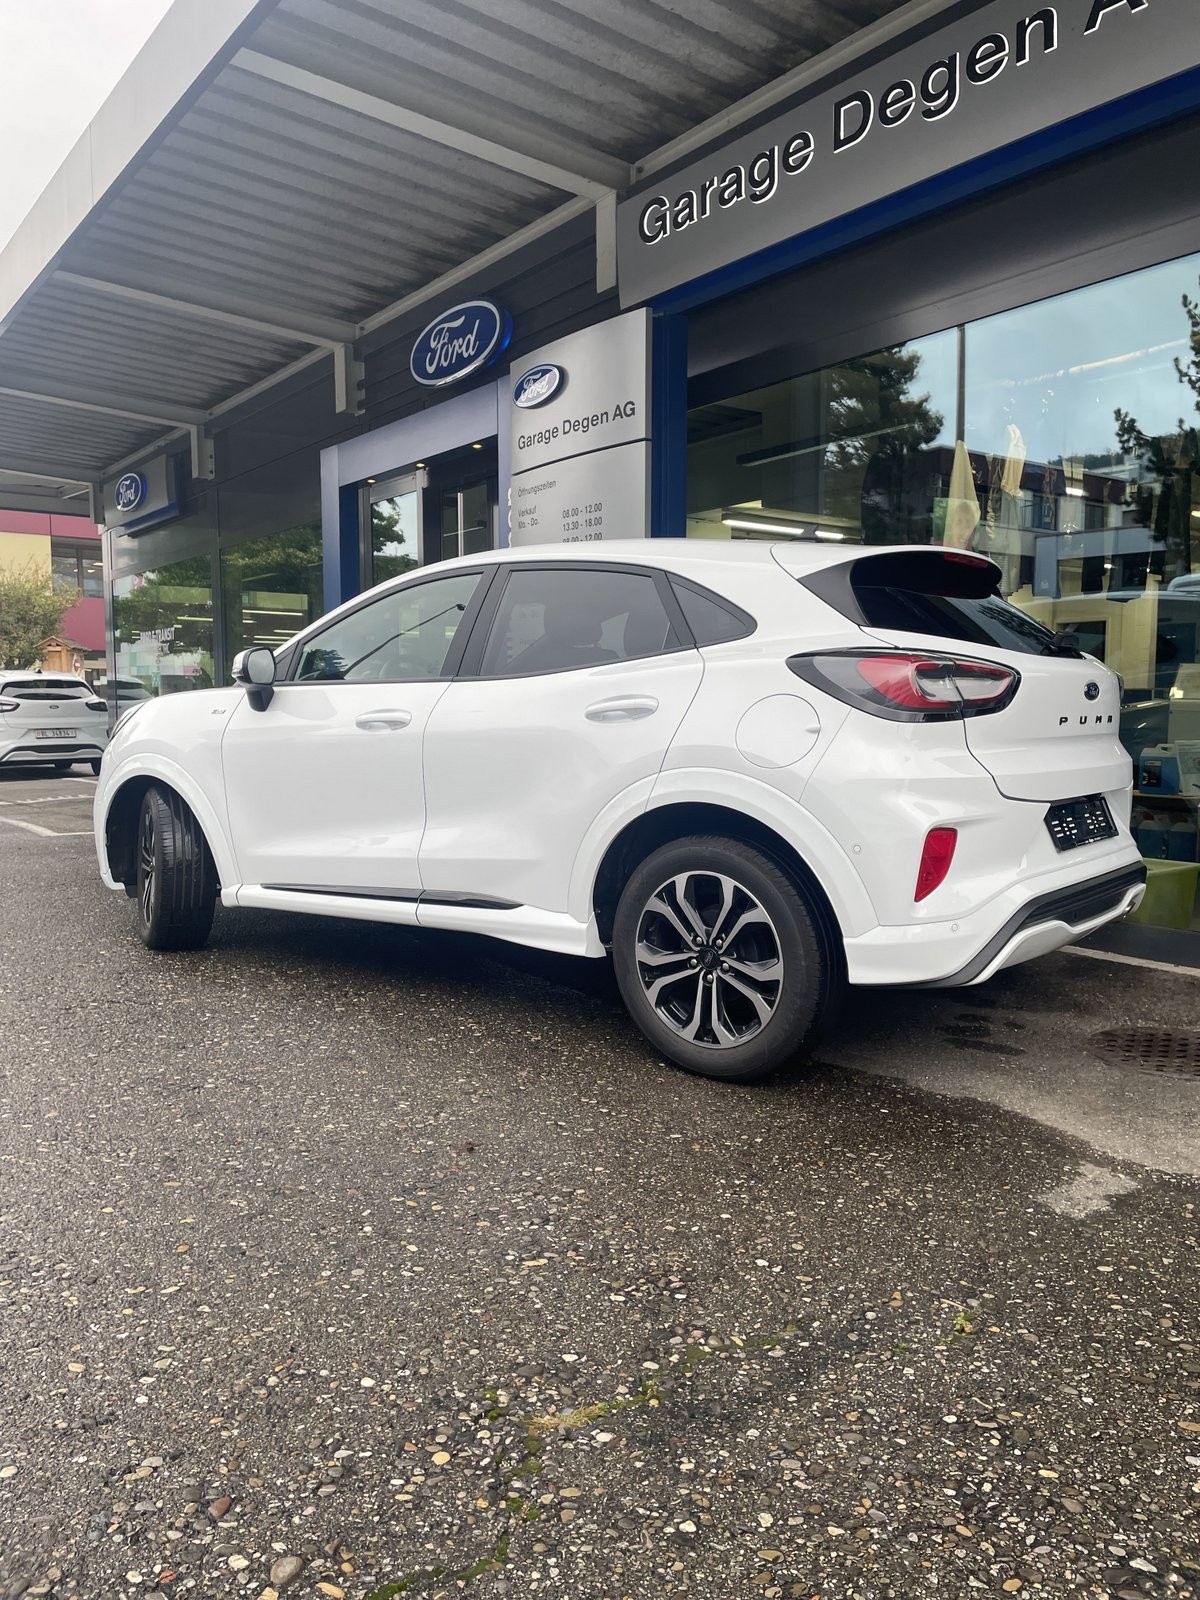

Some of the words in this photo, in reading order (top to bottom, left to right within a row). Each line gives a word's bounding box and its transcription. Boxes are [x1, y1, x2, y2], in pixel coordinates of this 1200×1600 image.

[639, 130, 814, 245] Garage
[833, 6, 1058, 154] Degen
[425, 315, 480, 374] Ford
[519, 372, 550, 401] Ford
[518, 426, 559, 450] Garage
[562, 411, 609, 435] Degen
[612, 400, 636, 421] AG
[118, 480, 135, 506] Ford
[517, 480, 557, 498] Öffnungszeiten
[518, 505, 537, 518] Verkauf
[562, 507, 579, 519] 08.00
[585, 502, 603, 514] 12.00
[563, 520, 579, 532] 13.30
[585, 516, 603, 528] 18.00
[585, 532, 603, 542] 1200
[1059, 715, 1113, 726] PUMA
